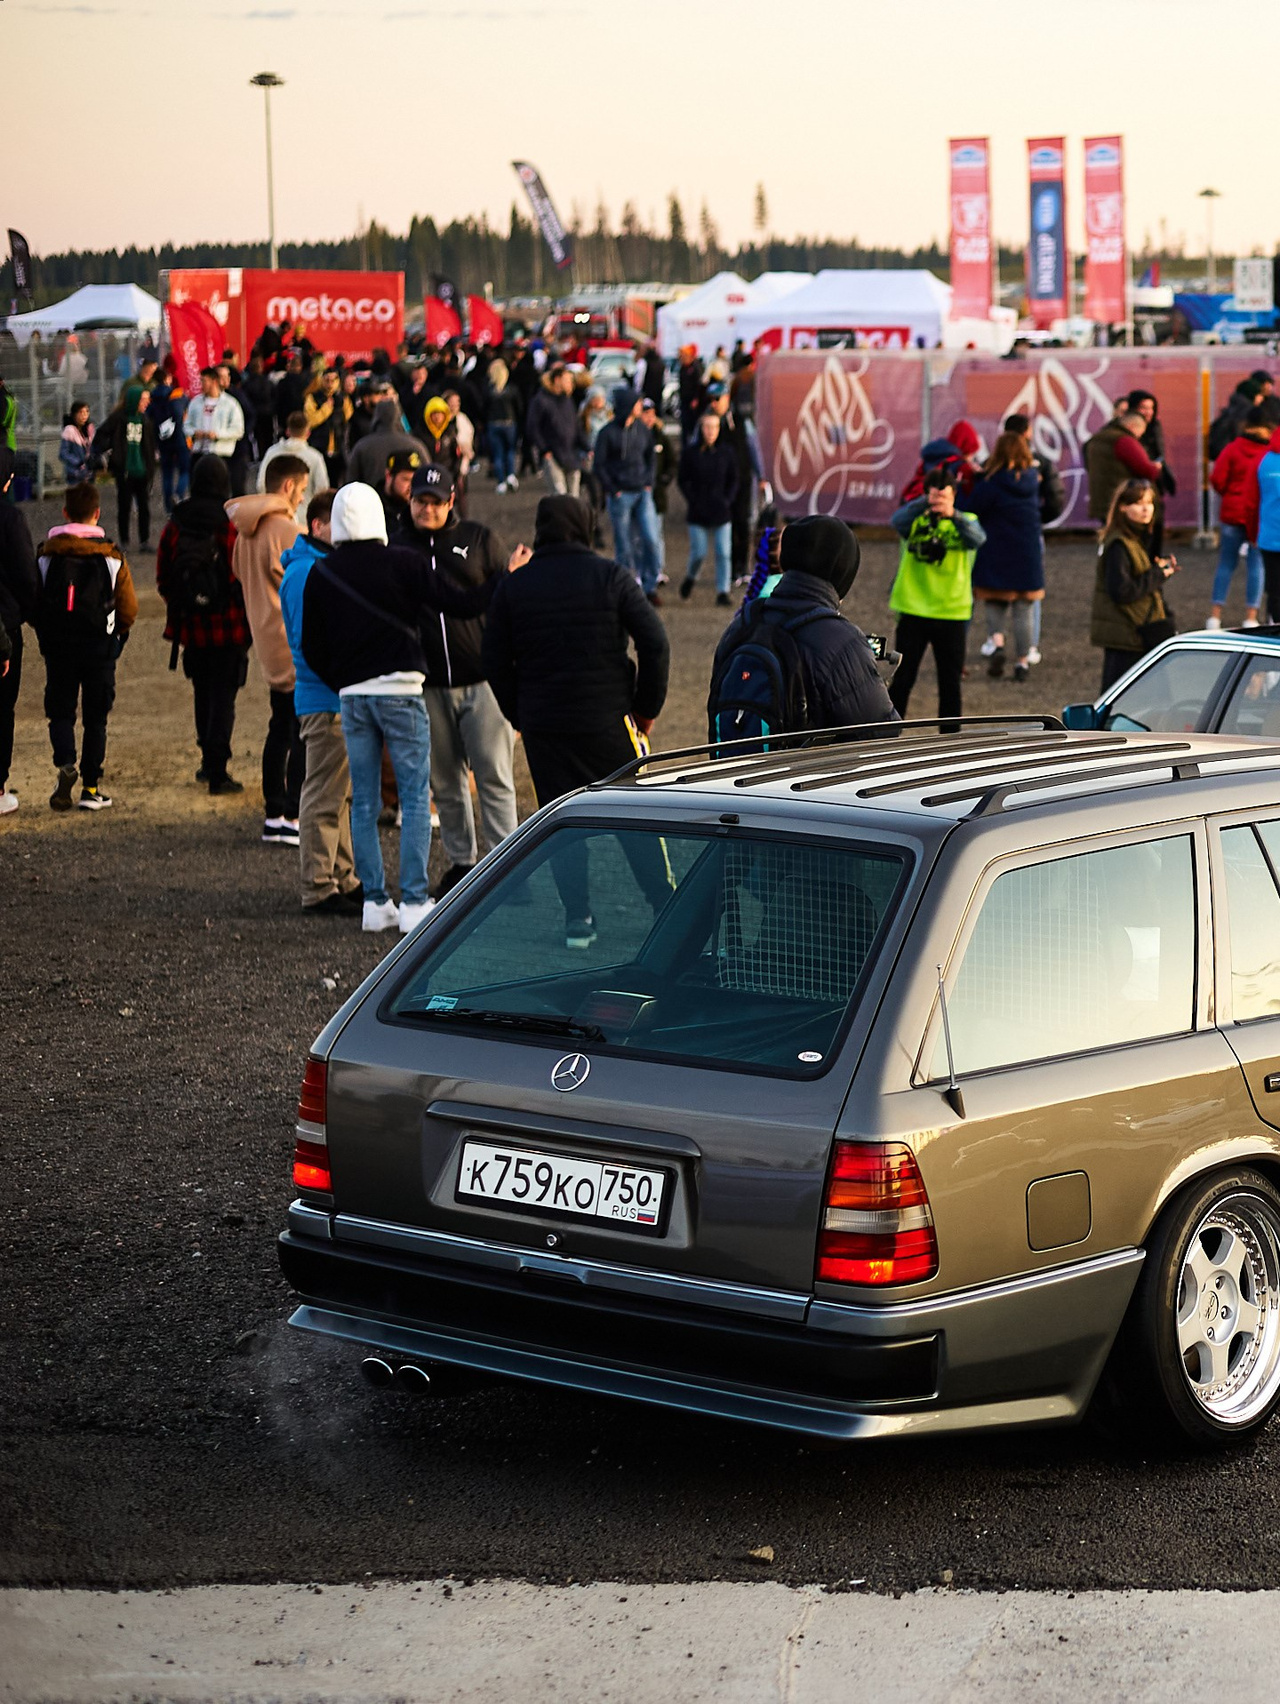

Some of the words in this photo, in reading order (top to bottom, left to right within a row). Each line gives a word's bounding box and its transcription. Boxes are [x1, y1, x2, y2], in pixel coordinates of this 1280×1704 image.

[266, 294, 395, 322] metaco
[604, 1170, 652, 1206] 750
[612, 1205, 637, 1219] RUS
